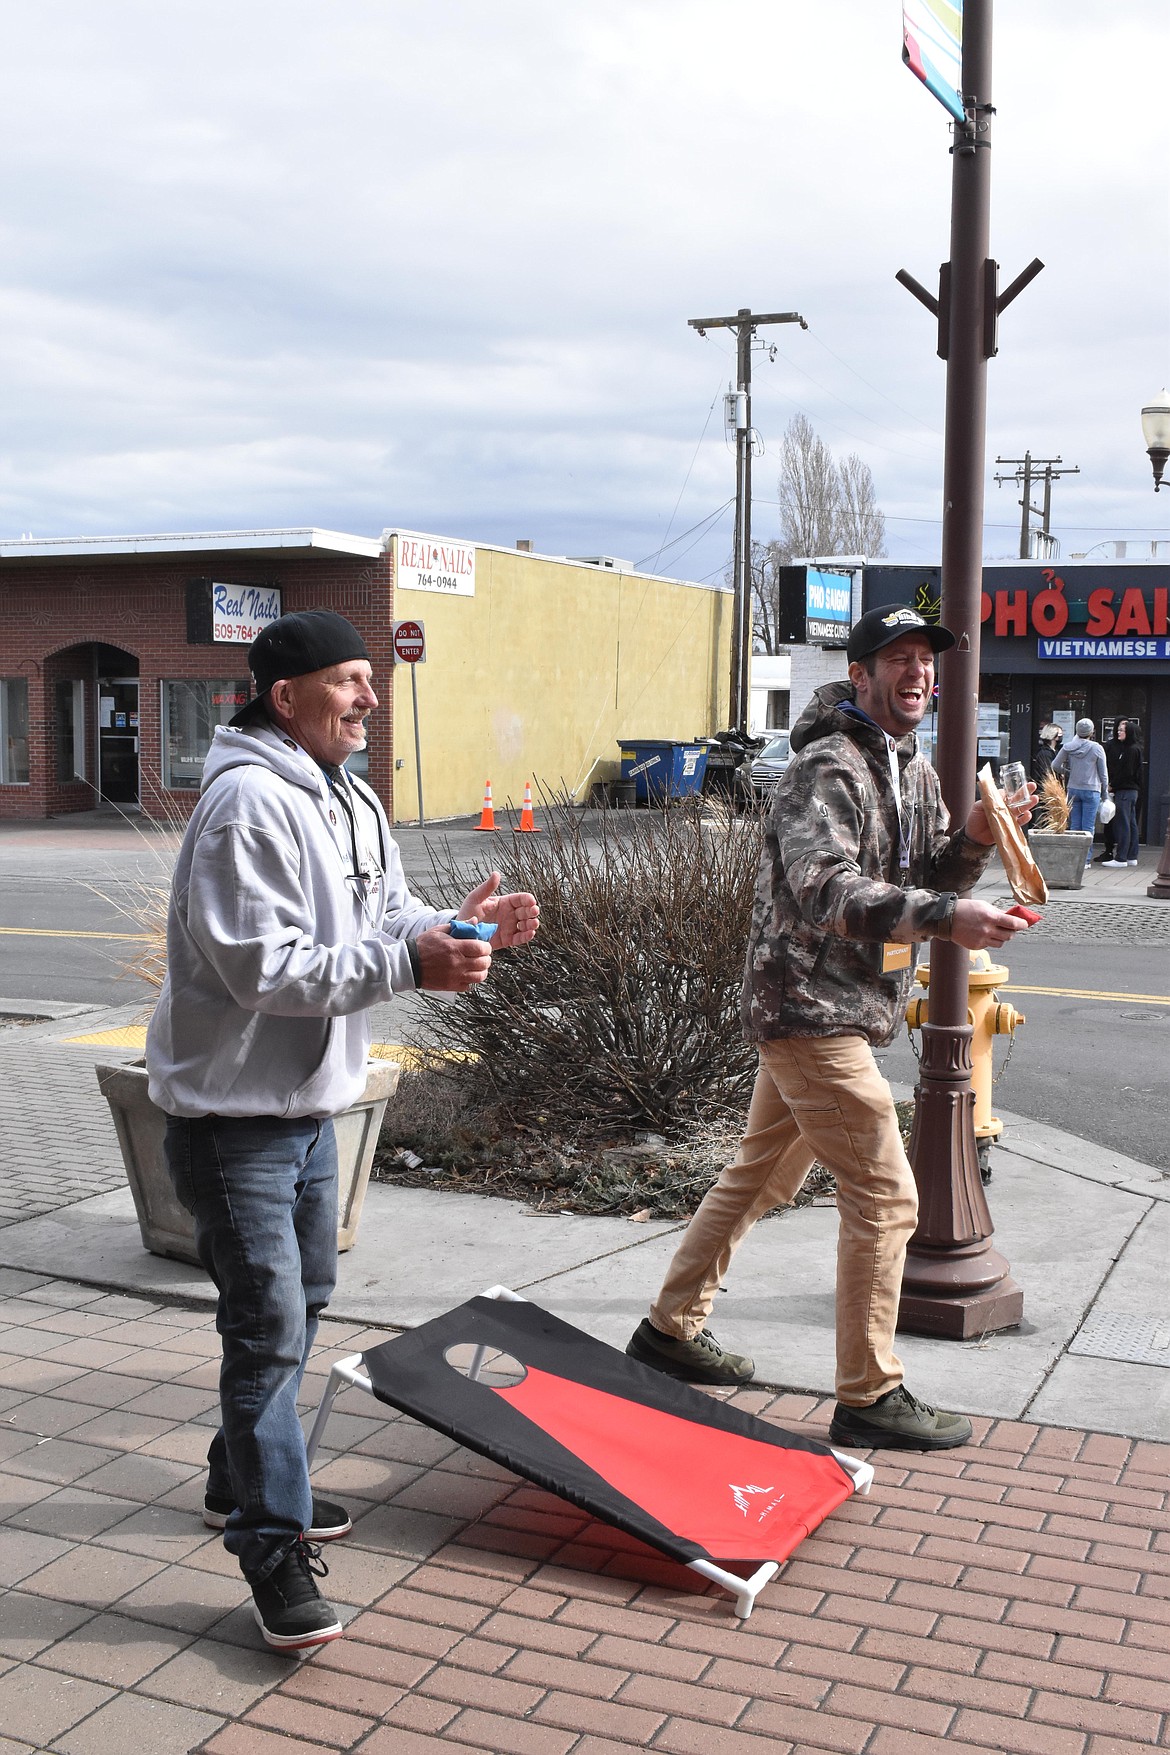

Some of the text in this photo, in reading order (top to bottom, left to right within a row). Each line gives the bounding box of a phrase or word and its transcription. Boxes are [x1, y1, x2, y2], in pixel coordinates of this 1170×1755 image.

[401, 541, 473, 575] REAL NAILS
[417, 573, 457, 589] 764-0944
[214, 585, 279, 620] Real Nails
[809, 621, 834, 637] VIETNAMESE
[1043, 641, 1157, 656] VIETNAMESE
[212, 694, 246, 705] WAXING
[1017, 703, 1030, 713] 115
